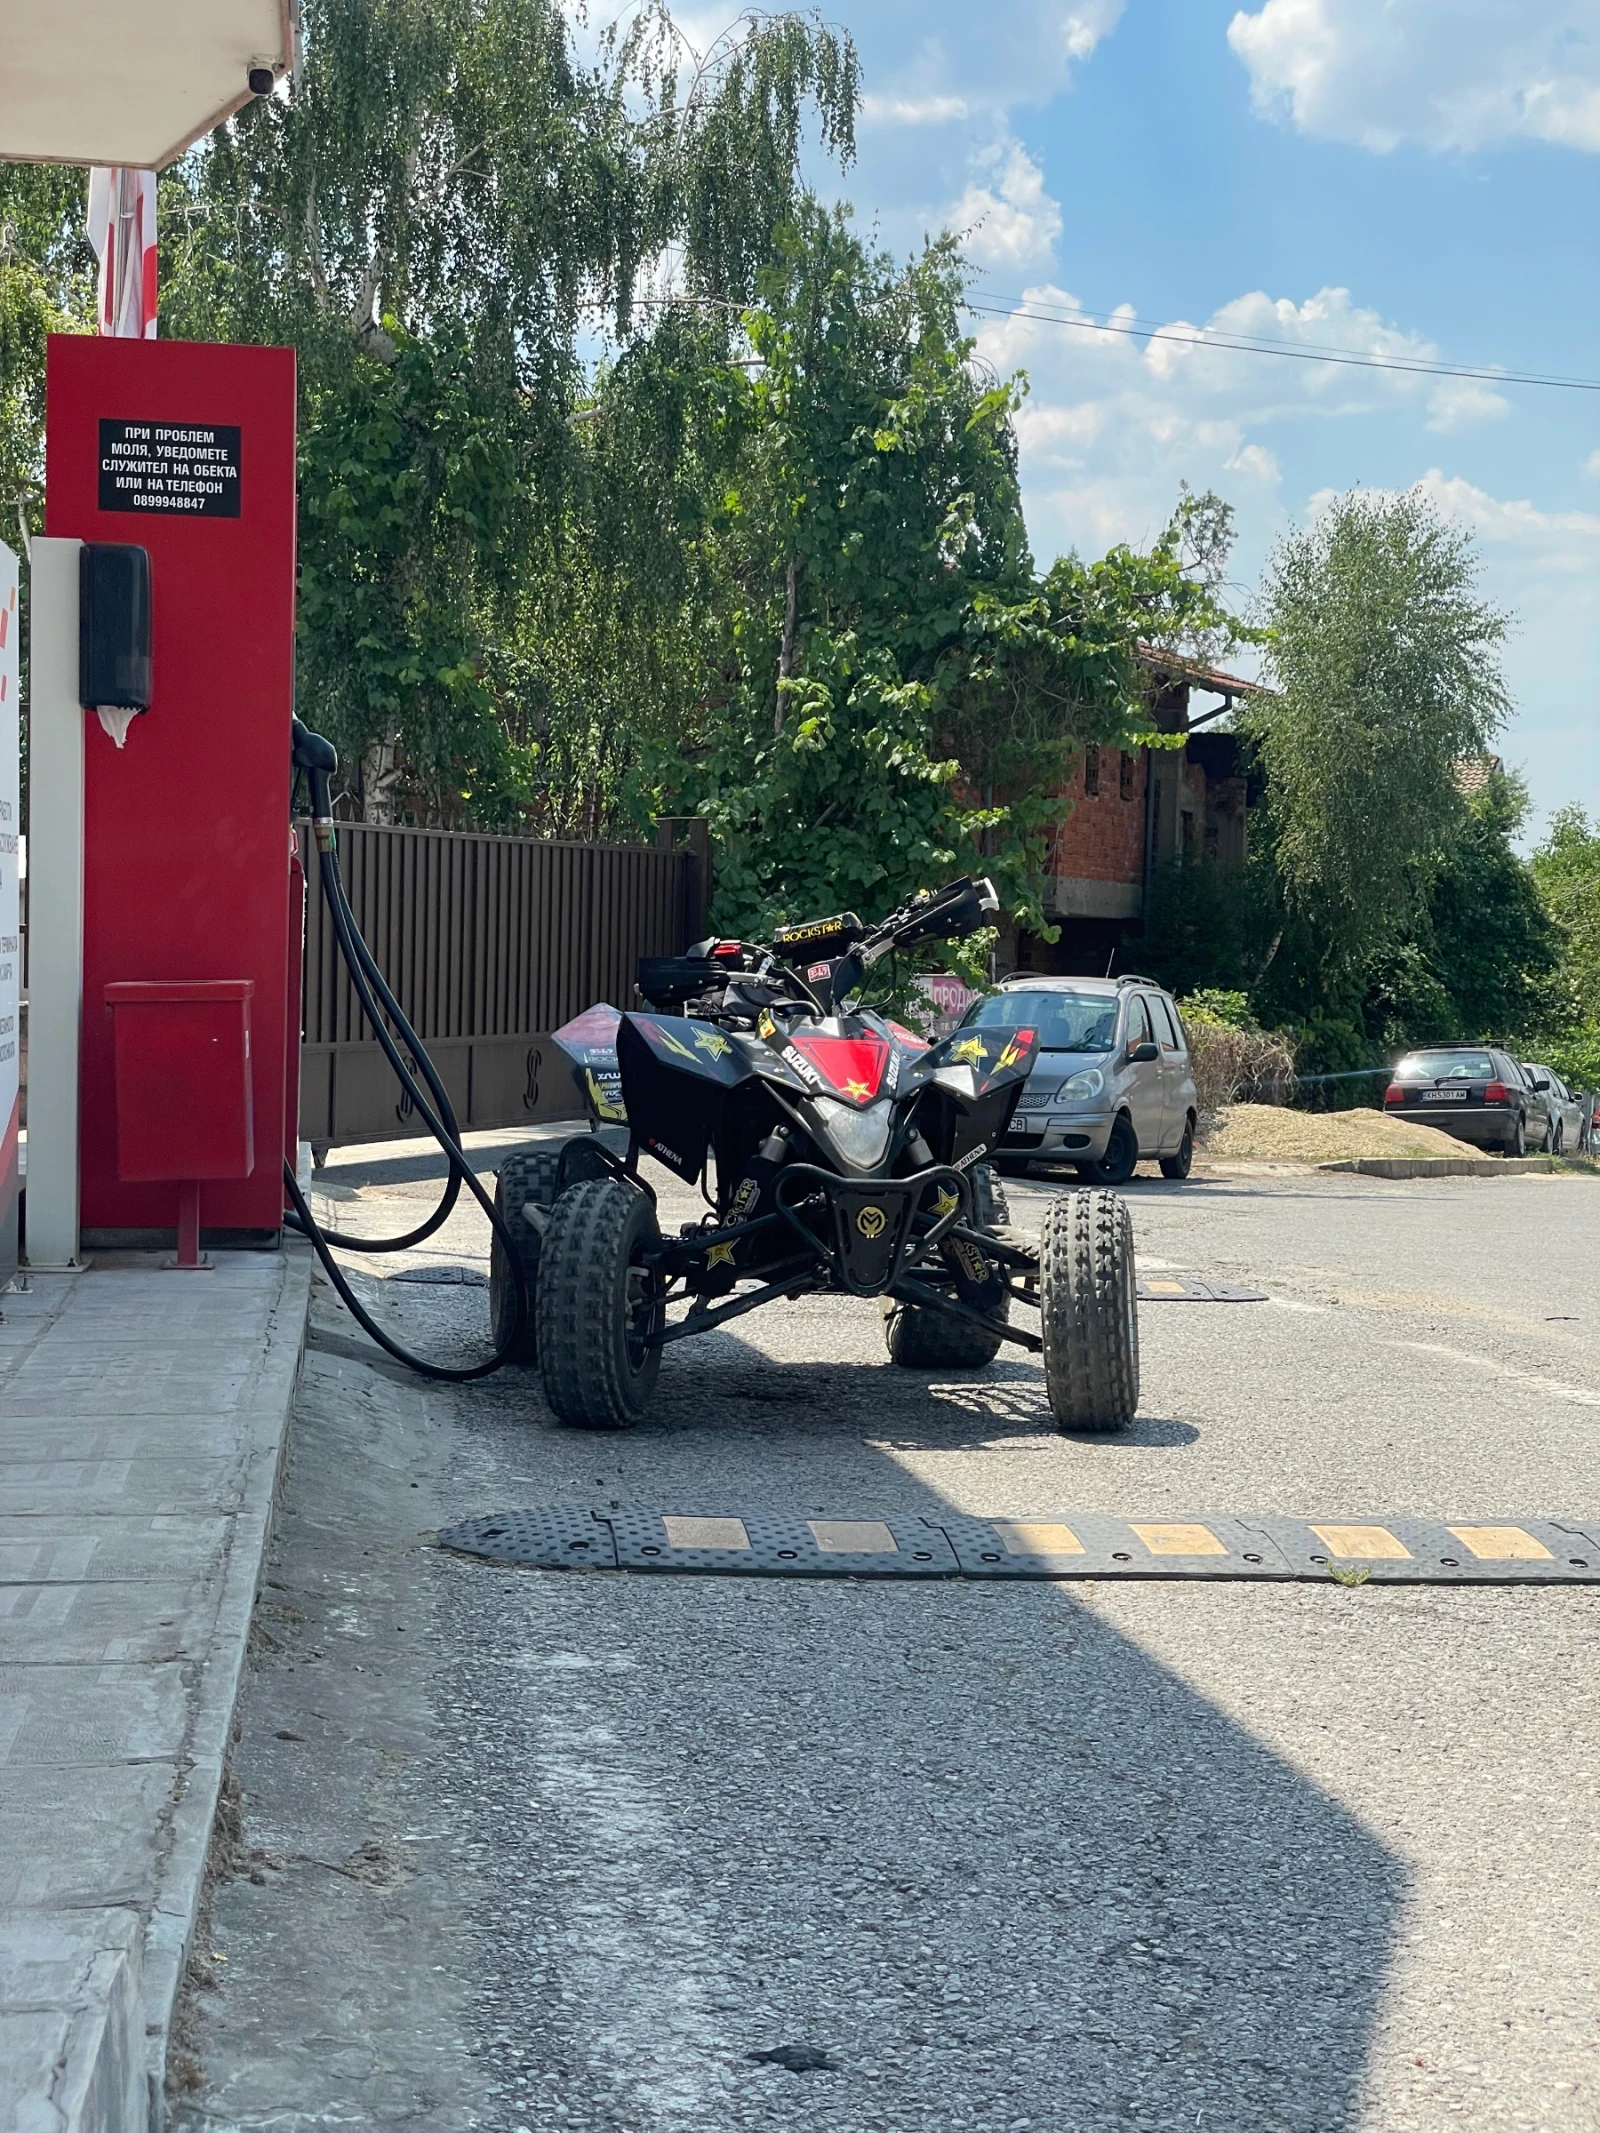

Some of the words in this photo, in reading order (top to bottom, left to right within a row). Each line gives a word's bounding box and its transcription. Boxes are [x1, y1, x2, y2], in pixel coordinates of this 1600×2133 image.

[125, 427, 150, 440] ПРИ
[155, 428, 214, 443] ПРОБЛЕМ
[111, 443, 151, 458] МОЛЯ,
[156, 445, 228, 461] УВЕДОМЕТЕ
[102, 459, 168, 474] СЛУЖИТЕЛ
[173, 463, 190, 475] НА
[193, 464, 237, 478] ОБЕКТА
[116, 476, 142, 489] ИЛИ
[147, 478, 164, 491] НА
[166, 479, 223, 494] ТЕЛЕФОН
[133, 494, 205, 510] 0899948847
[781, 1045, 821, 1085] SUZUKI
[886, 1049, 901, 1089] SUZUKI
[654, 1142, 683, 1166] ATHENA
[959, 1146, 985, 1167] ATHENA
